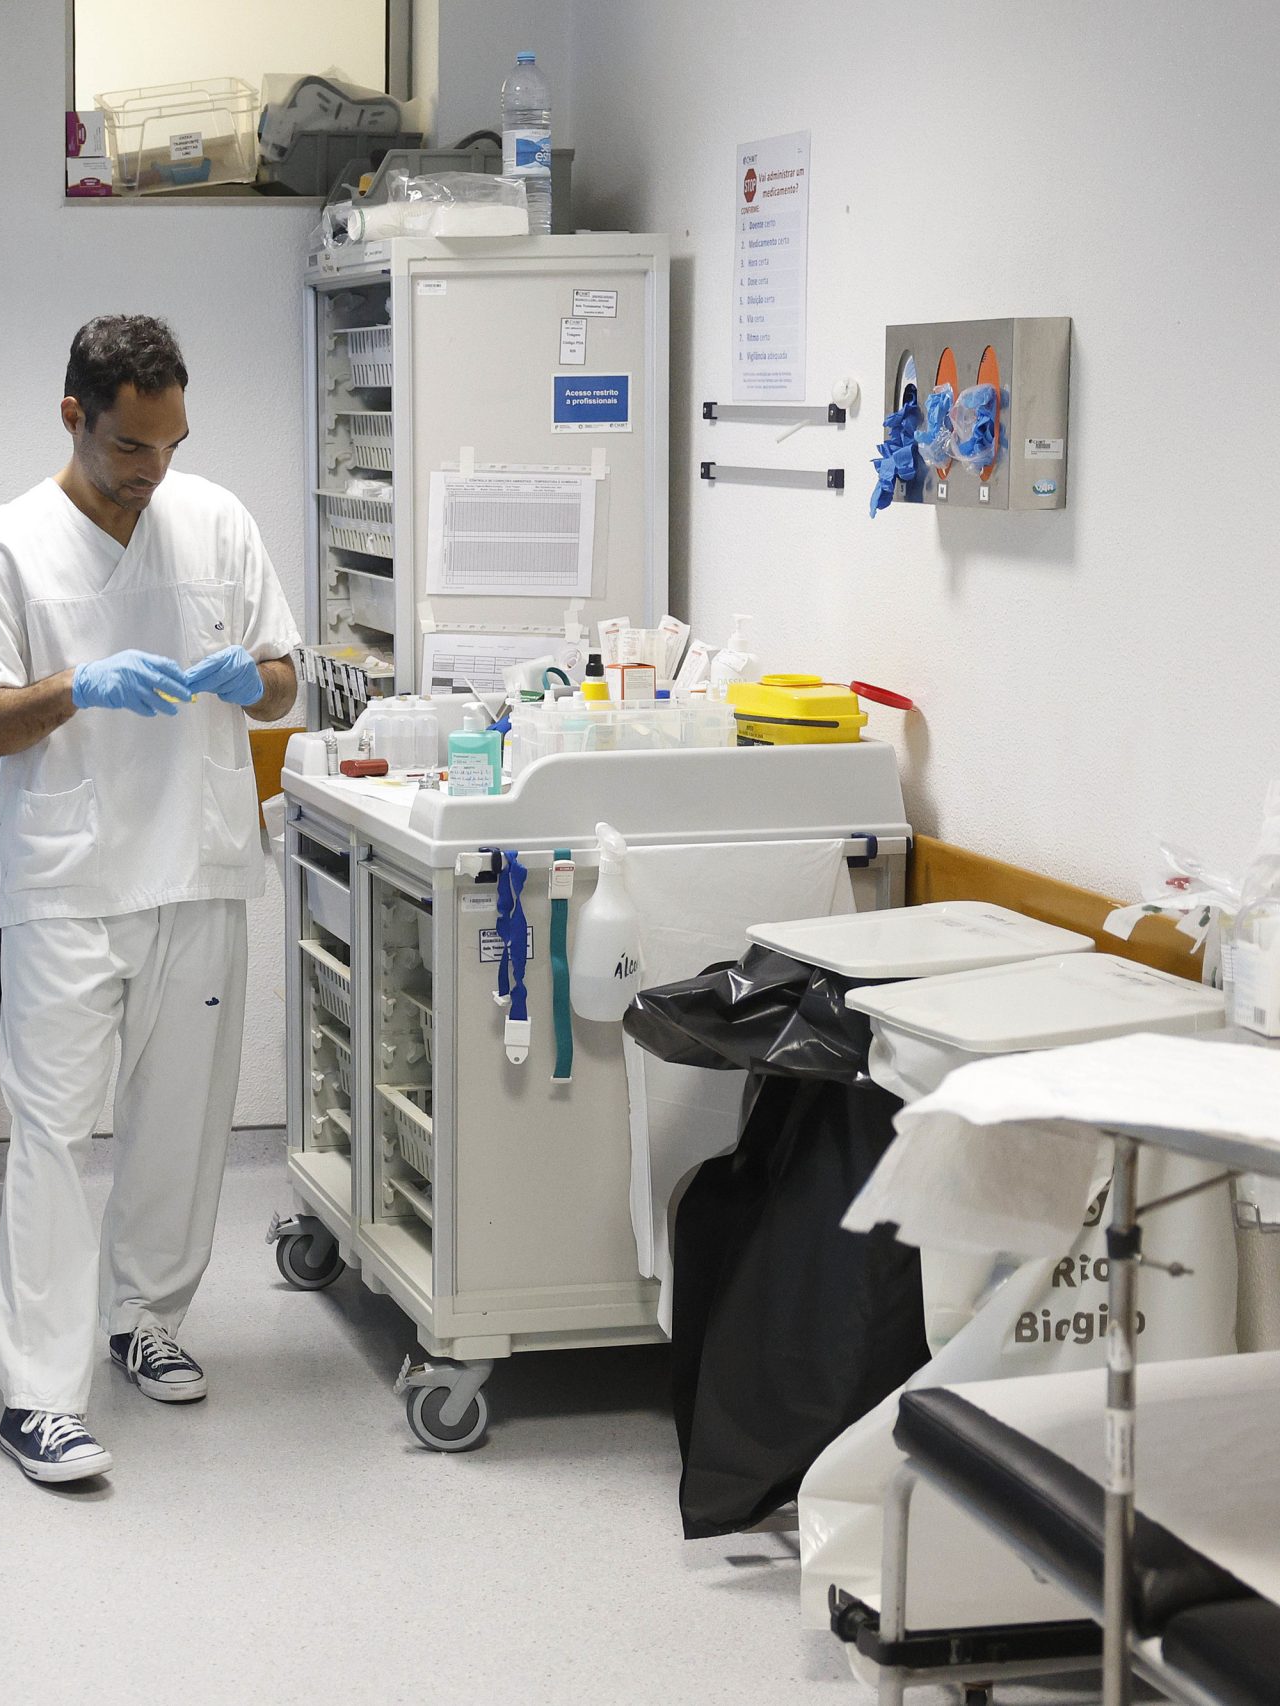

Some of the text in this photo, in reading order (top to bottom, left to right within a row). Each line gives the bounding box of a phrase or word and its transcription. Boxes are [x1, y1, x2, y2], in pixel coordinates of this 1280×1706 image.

[767, 168, 796, 182] administrar
[744, 178, 757, 194] STOP
[762, 182, 799, 198] medicamento?
[572, 397, 618, 406] profissionais
